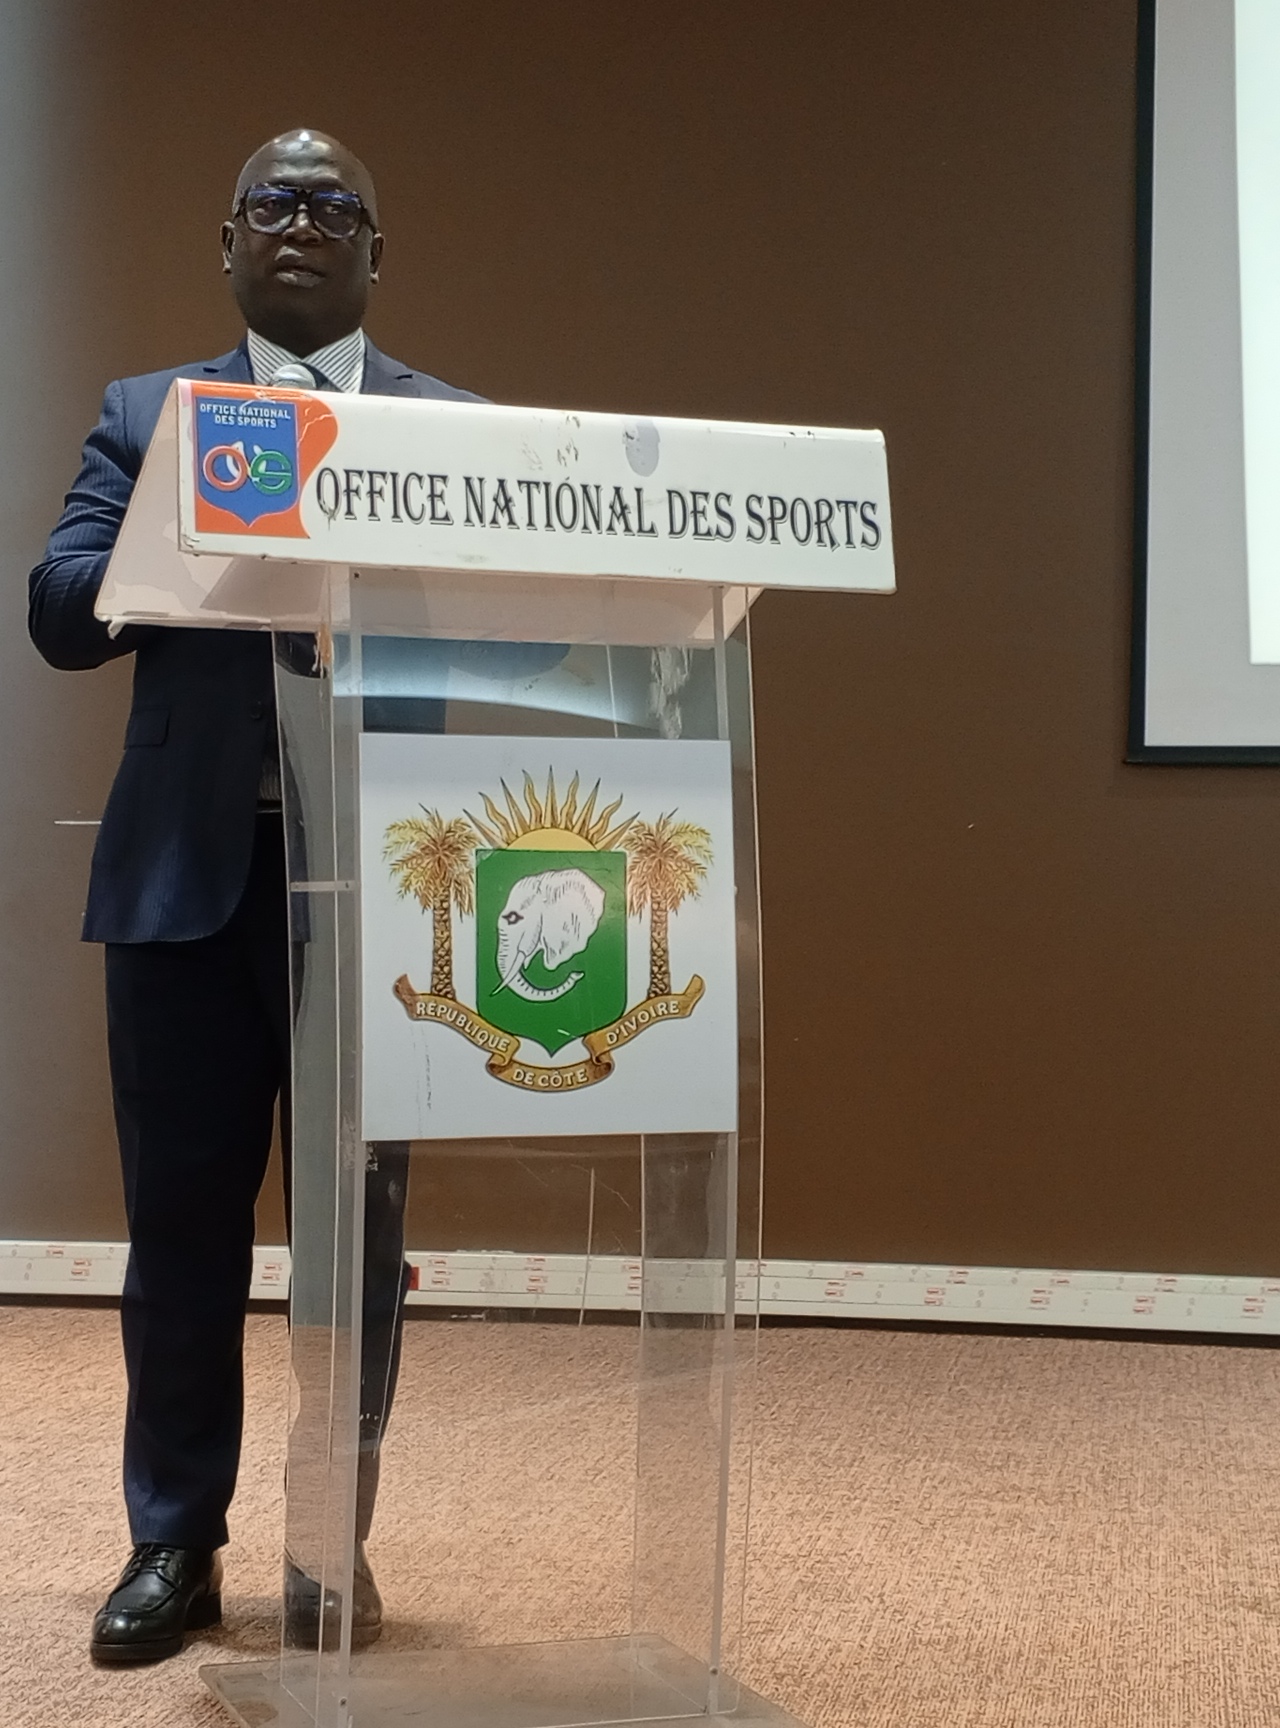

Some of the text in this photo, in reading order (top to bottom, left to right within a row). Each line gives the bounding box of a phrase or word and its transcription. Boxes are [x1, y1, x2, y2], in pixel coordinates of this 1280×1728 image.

[199, 403, 291, 420] OFFICE NATIONAL
[214, 415, 277, 429] DES SPORTS
[316, 467, 882, 551] OFFICE NATIONAL DES SPORTS
[513, 1069, 535, 1085] DE
[538, 1068, 588, 1087] CÔTE
[606, 1000, 679, 1045] D'IVOIRE
